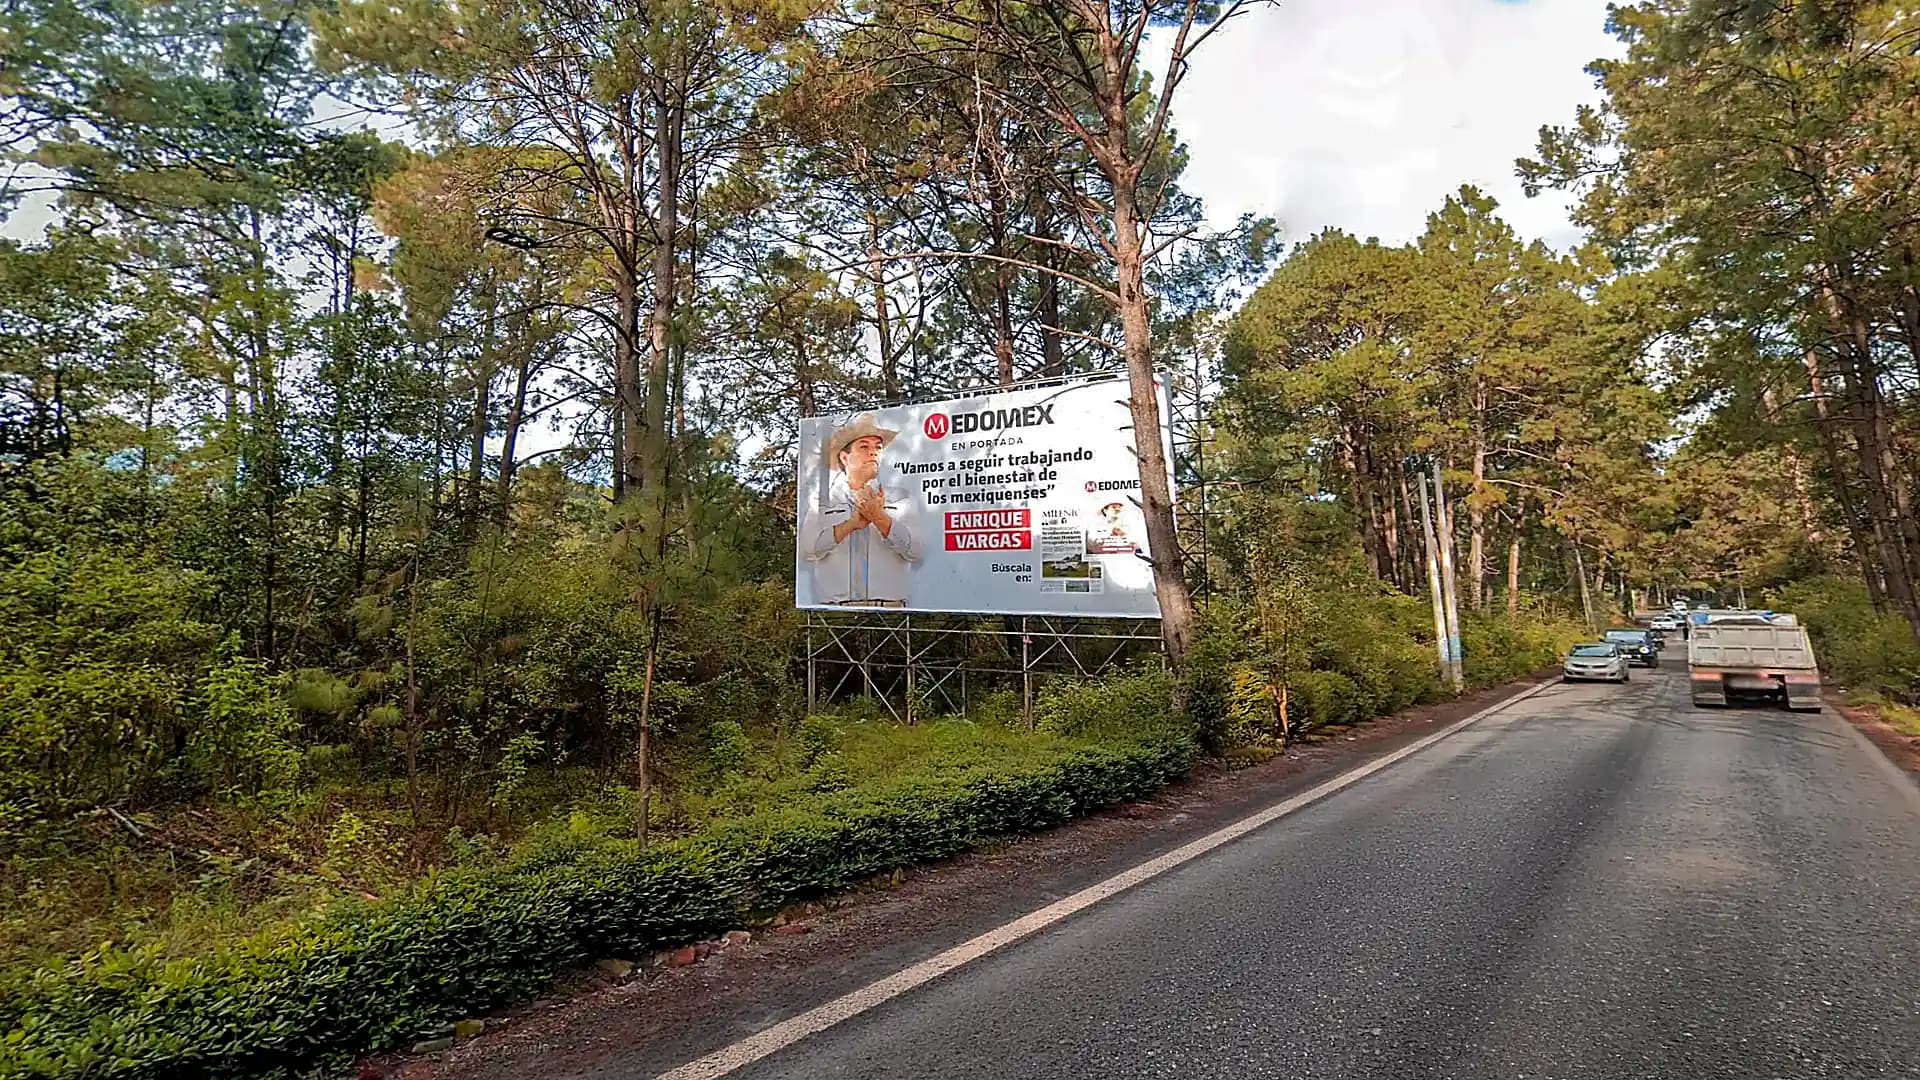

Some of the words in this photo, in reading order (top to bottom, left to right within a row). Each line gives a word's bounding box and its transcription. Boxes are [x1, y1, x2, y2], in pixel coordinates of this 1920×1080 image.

[952, 404, 1055, 434] EDOMEX
[951, 442, 966, 451] EN
[970, 437, 1024, 449] PORTADA
[948, 461, 956, 471] a
[959, 454, 1004, 472] seguir
[1008, 447, 1093, 467] trabajando
[922, 478, 945, 491] por
[949, 474, 961, 487] el
[965, 471, 1034, 486] bienestar
[1038, 468, 1057, 481] de
[928, 492, 946, 505] los
[950, 512, 1023, 529] ENRIQUE
[955, 533, 1022, 549] VARGAS
[992, 563, 1032, 573] Búscala
[1015, 574, 1032, 582] en:
